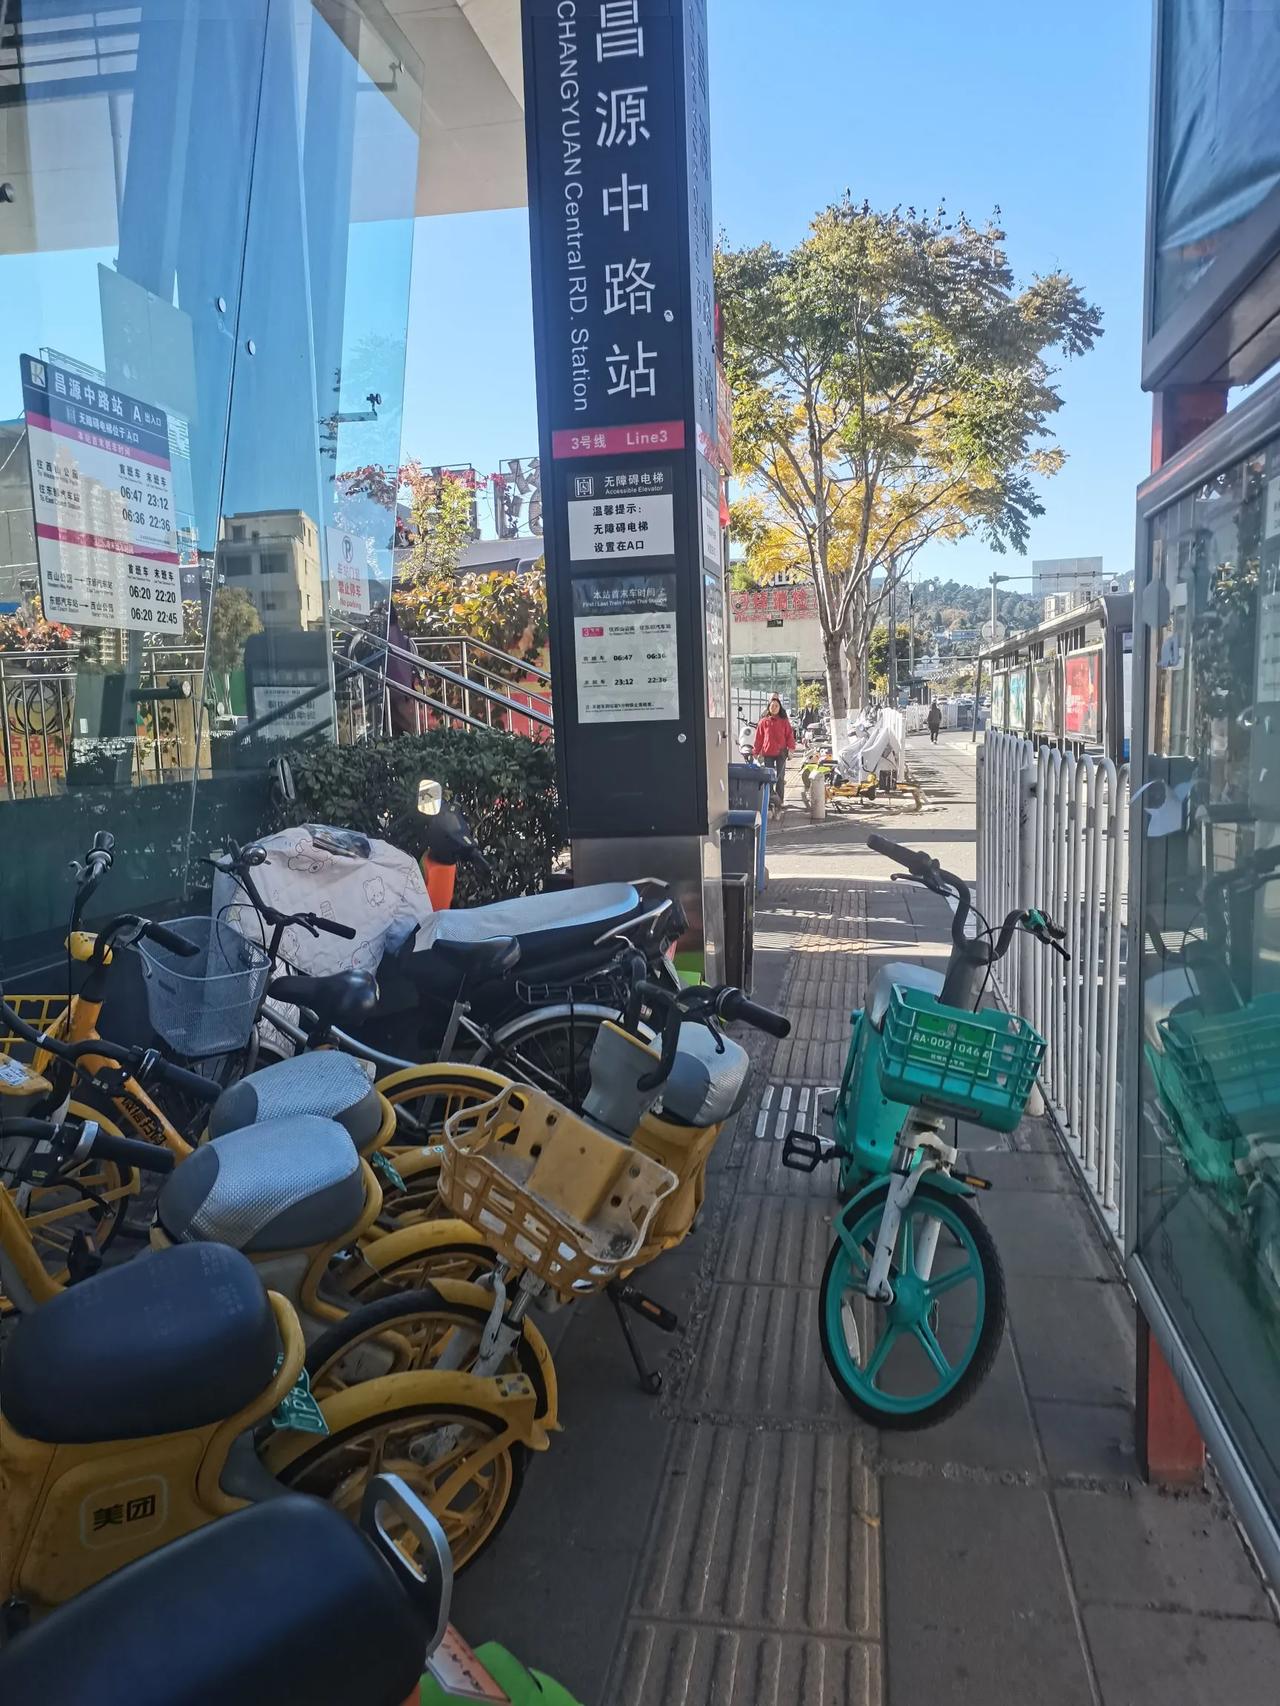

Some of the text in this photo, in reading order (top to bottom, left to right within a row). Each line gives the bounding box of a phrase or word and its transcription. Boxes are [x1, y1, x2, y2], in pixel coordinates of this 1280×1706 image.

[557, 1, 590, 411] CHANGYUAN Central RD. Station
[596, 0, 657, 398] 昌源中路站
[54, 371, 124, 417] 昌源中路站
[132, 404, 142, 423] A
[571, 430, 668, 450] 3号线 Line3
[604, 472, 664, 488] 无障碍电梯
[120, 485, 143, 504] 06:47
[147, 493, 169, 511] 23:12
[605, 485, 663, 496] Accessible Elevator
[122, 508, 171, 532] 06:36 22:36
[594, 521, 648, 535] 无障碍电梯
[594, 540, 644, 553] 设置在A口
[129, 585, 151, 600] 06:20
[155, 589, 176, 603] 22:20
[131, 607, 153, 621] 06:20
[156, 611, 178, 624] 22:45
[614, 678, 634, 686] 23:12
[93, 1494, 156, 1532] 美团
